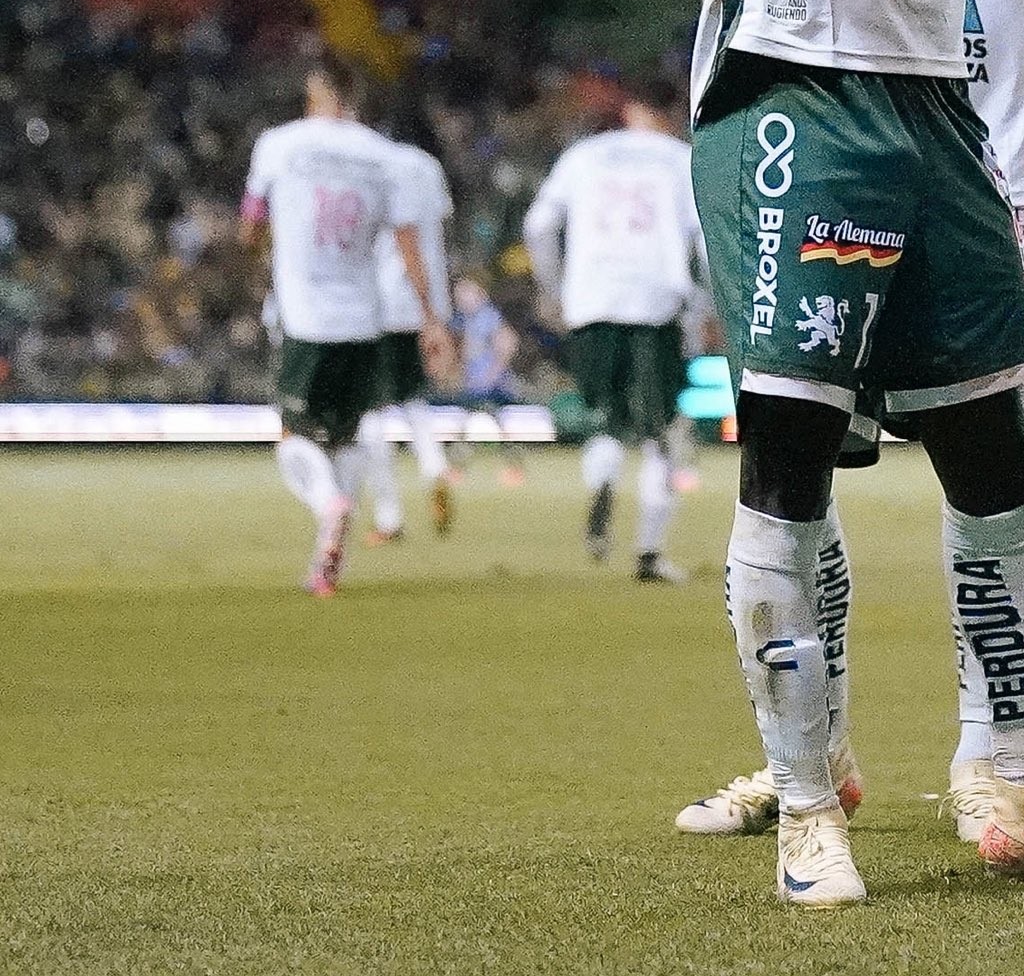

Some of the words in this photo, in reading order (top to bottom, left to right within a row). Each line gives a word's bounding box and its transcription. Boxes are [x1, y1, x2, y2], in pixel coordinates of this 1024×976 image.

[807, 215, 830, 244] La
[833, 219, 905, 249] Alemana
[750, 207, 784, 345] BROXEL
